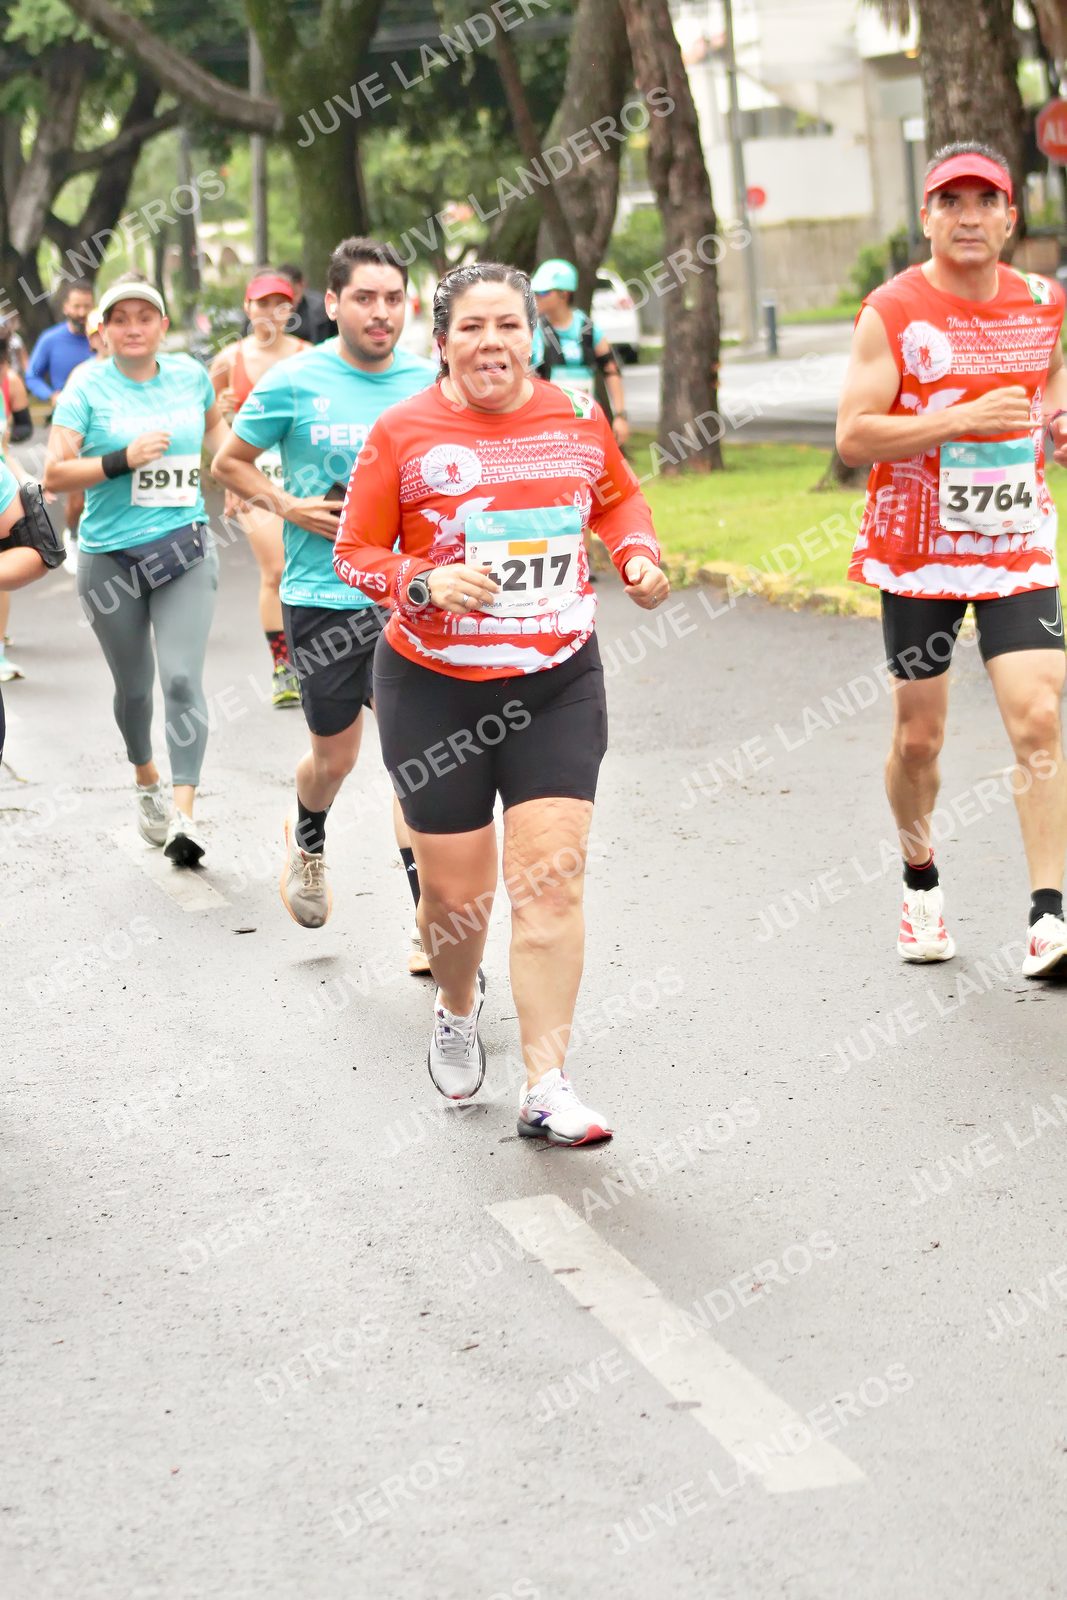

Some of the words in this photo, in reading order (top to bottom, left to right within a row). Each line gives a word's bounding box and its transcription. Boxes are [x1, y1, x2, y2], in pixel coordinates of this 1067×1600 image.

[947, 317, 968, 330] Viva
[971, 314, 1032, 331] Aguascalientes
[138, 469, 200, 490] 5918
[946, 482, 1033, 513] 3764
